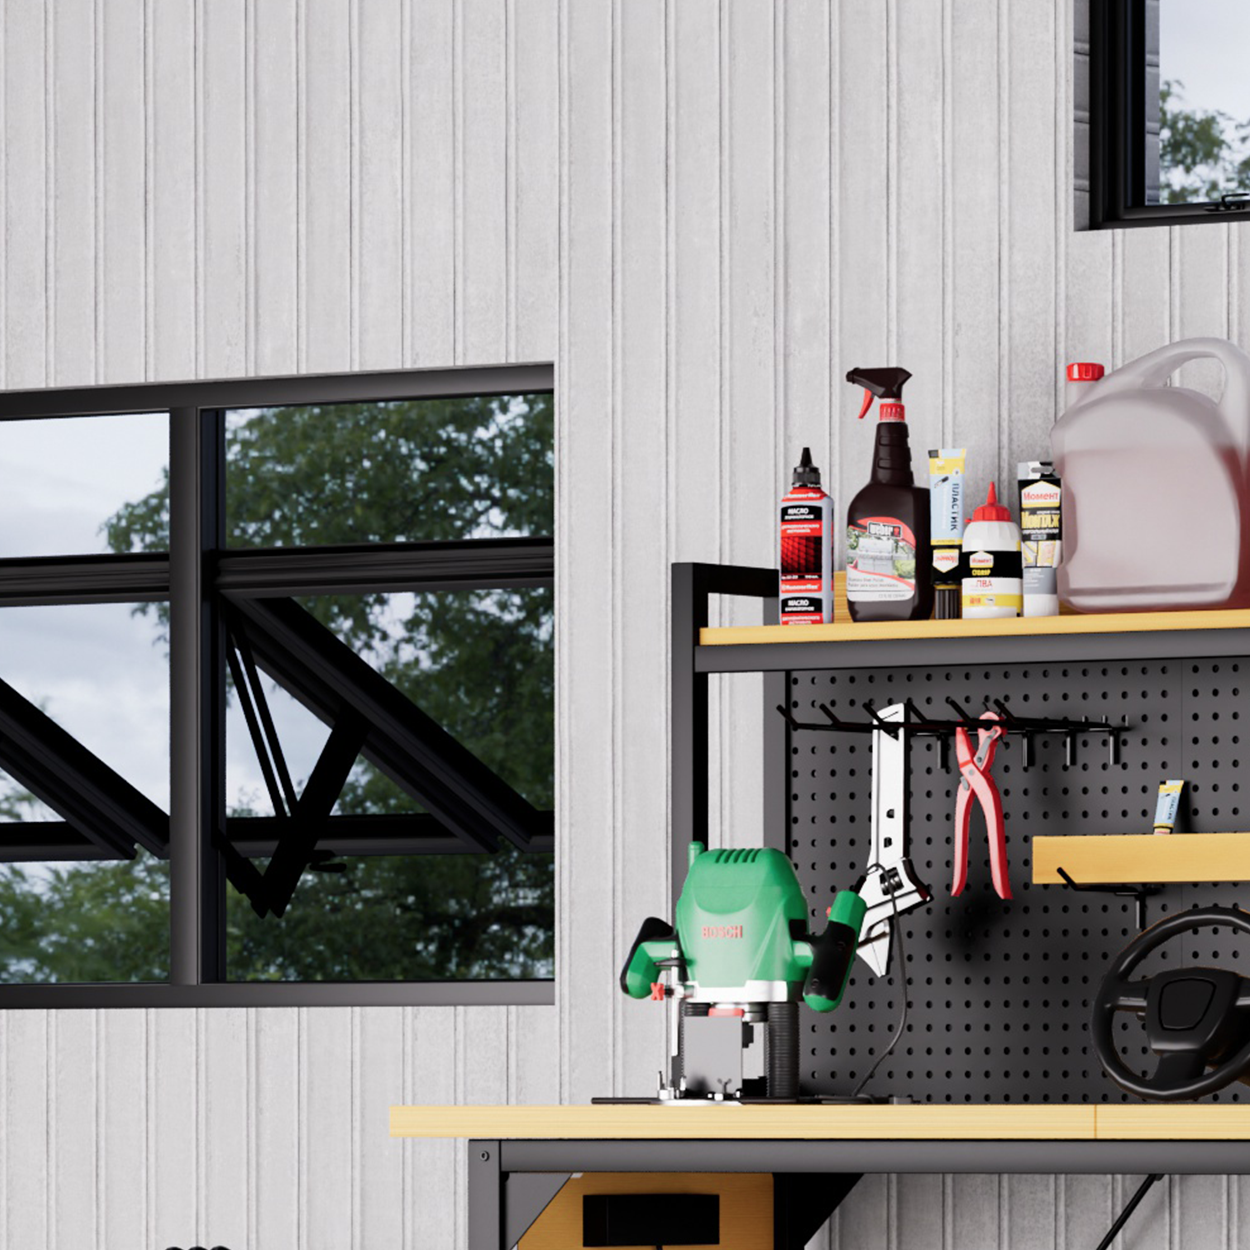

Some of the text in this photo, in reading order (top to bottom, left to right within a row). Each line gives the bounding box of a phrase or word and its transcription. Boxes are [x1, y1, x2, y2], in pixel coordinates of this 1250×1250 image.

[1024, 491, 1059, 500] Момент
[950, 483, 960, 531] ПЛАСТИК
[702, 925, 743, 939] BOSCH
